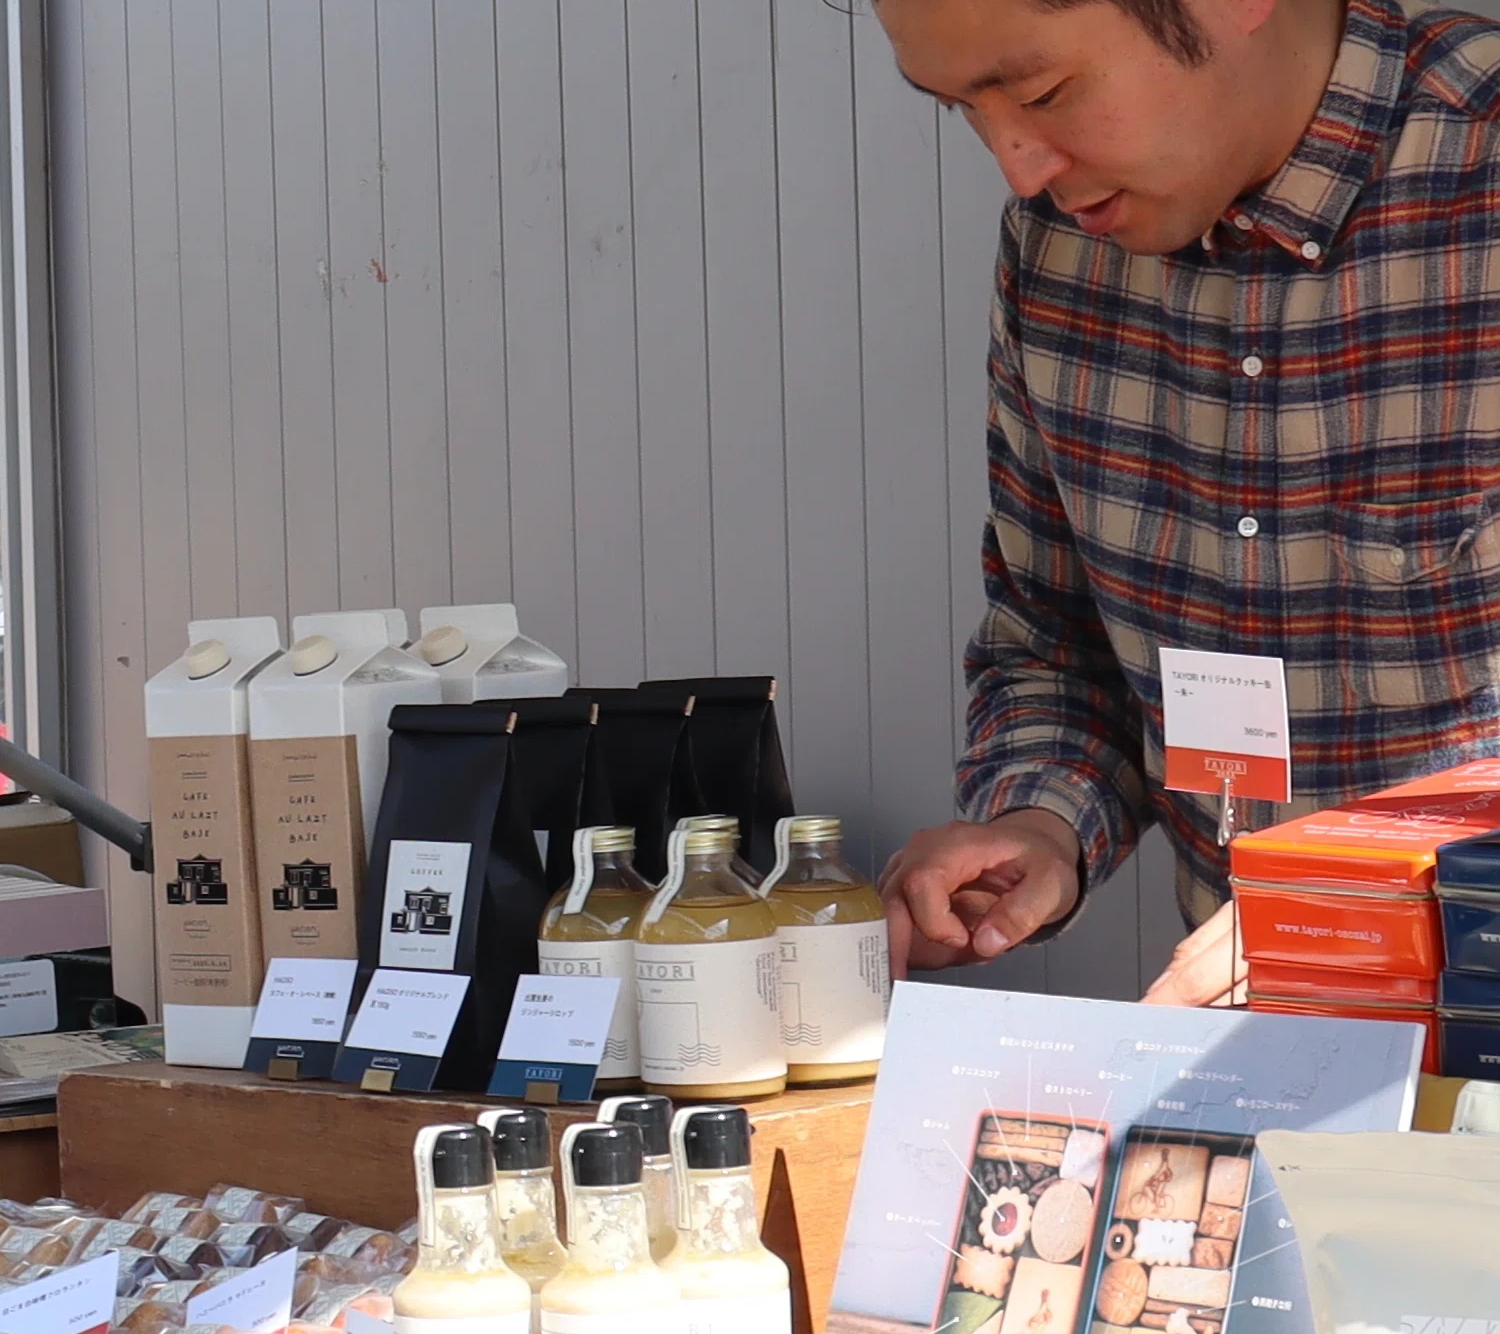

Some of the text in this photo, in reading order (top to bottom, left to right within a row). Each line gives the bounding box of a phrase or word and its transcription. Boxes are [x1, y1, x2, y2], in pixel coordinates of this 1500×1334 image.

[1172, 671, 1199, 682] TAYORI
[1265, 731, 1278, 739] yen
[1205, 758, 1247, 774] TAYORI
[525, 1068, 562, 1079] TAYORI
